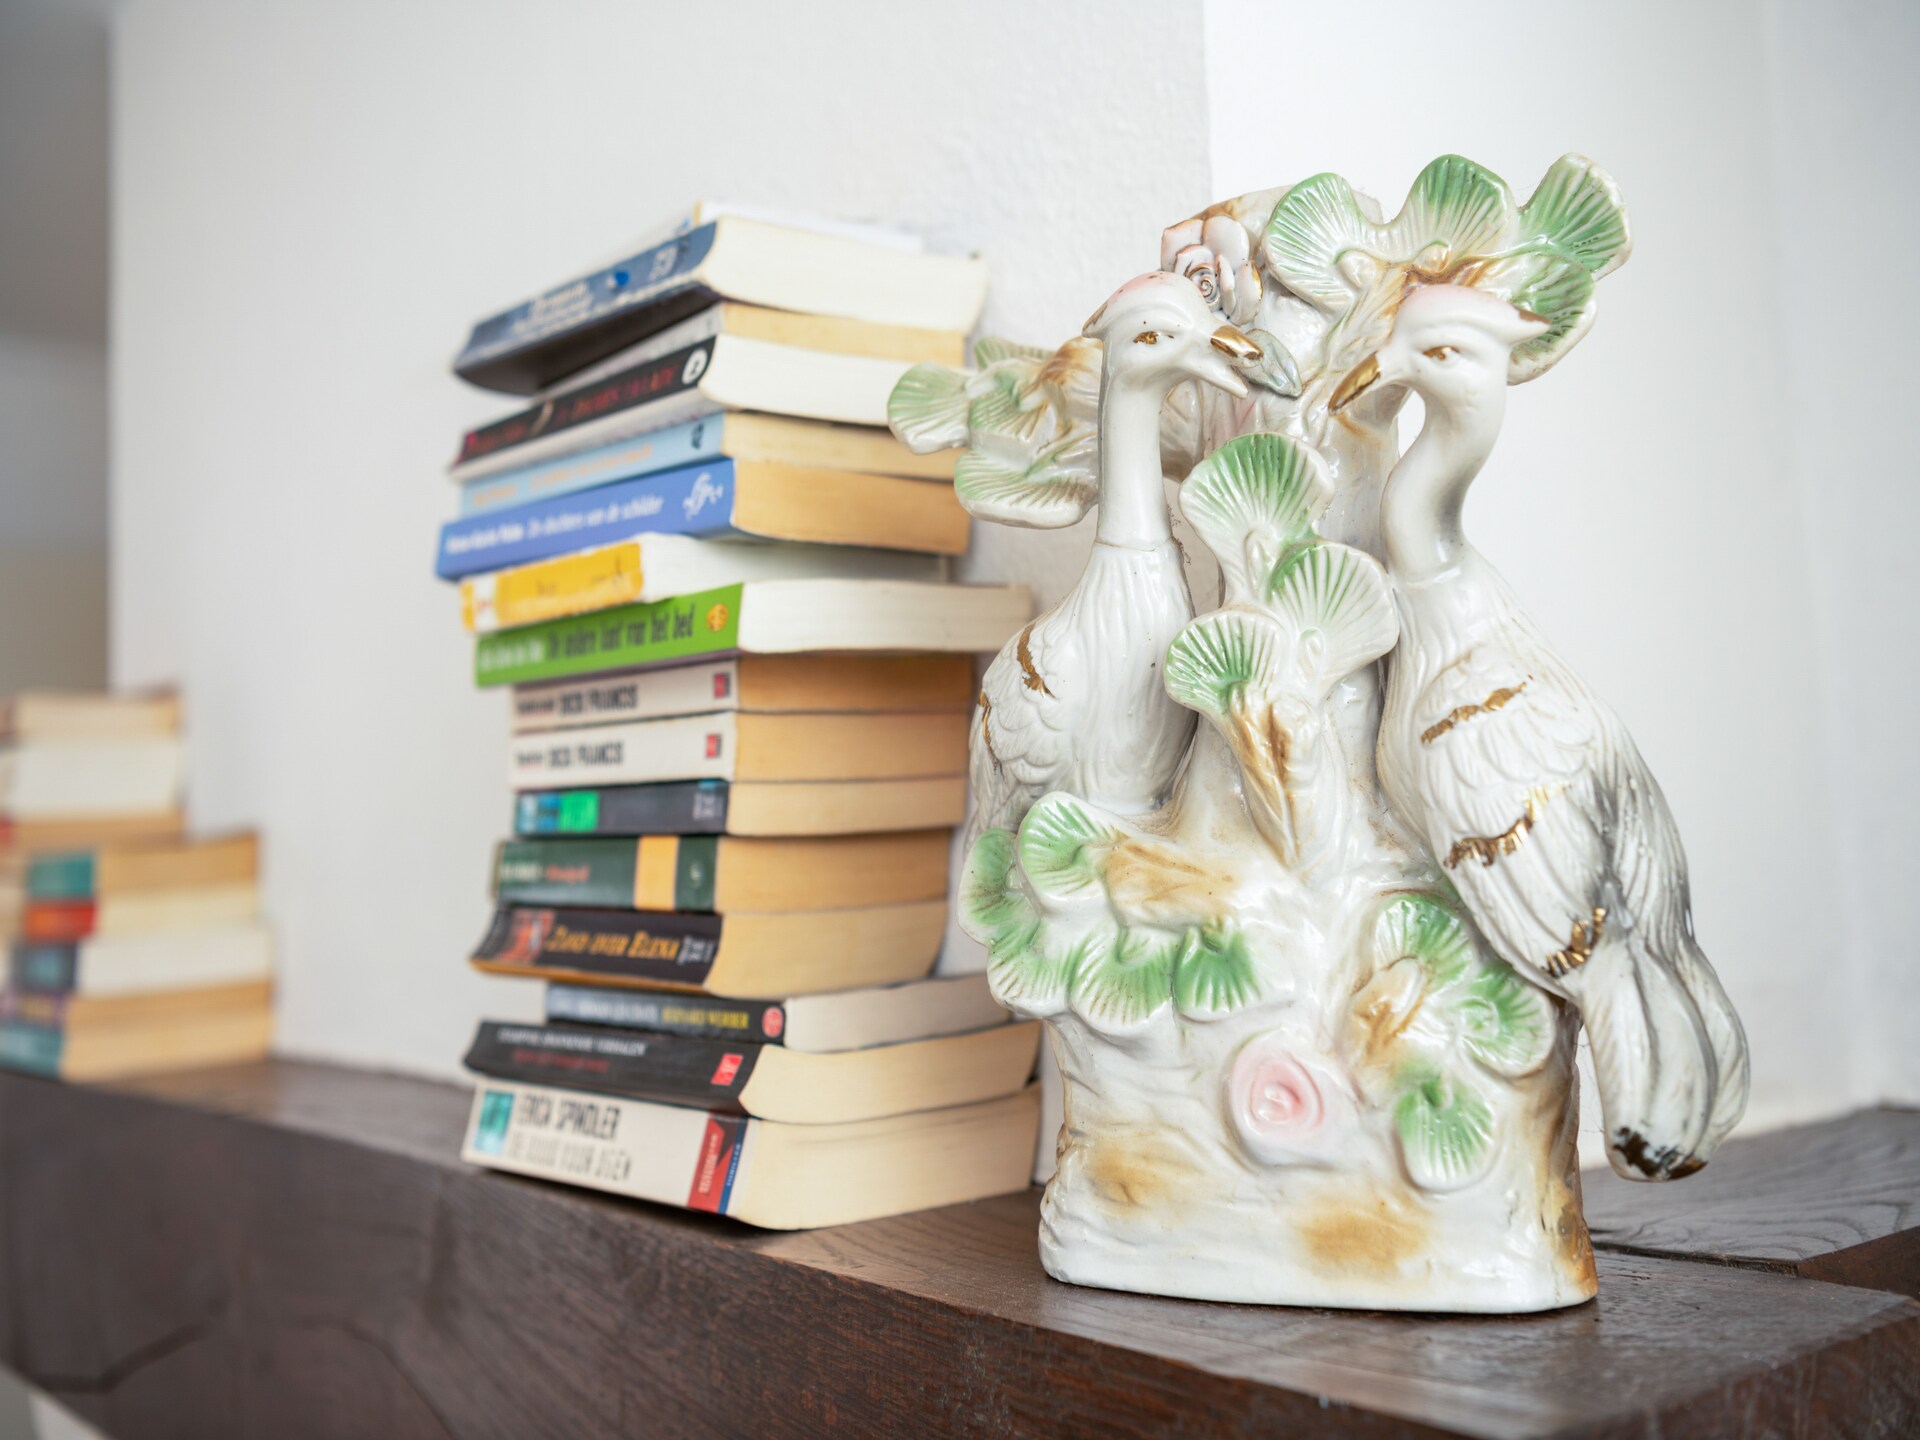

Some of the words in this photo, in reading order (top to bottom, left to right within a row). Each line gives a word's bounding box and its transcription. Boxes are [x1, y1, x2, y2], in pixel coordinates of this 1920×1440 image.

[650, 609, 669, 643] het
[672, 603, 695, 639] bed
[588, 684, 639, 713] FRANCIS
[577, 741, 624, 767] FRANCIS
[555, 1097, 622, 1140] SPINDLER
